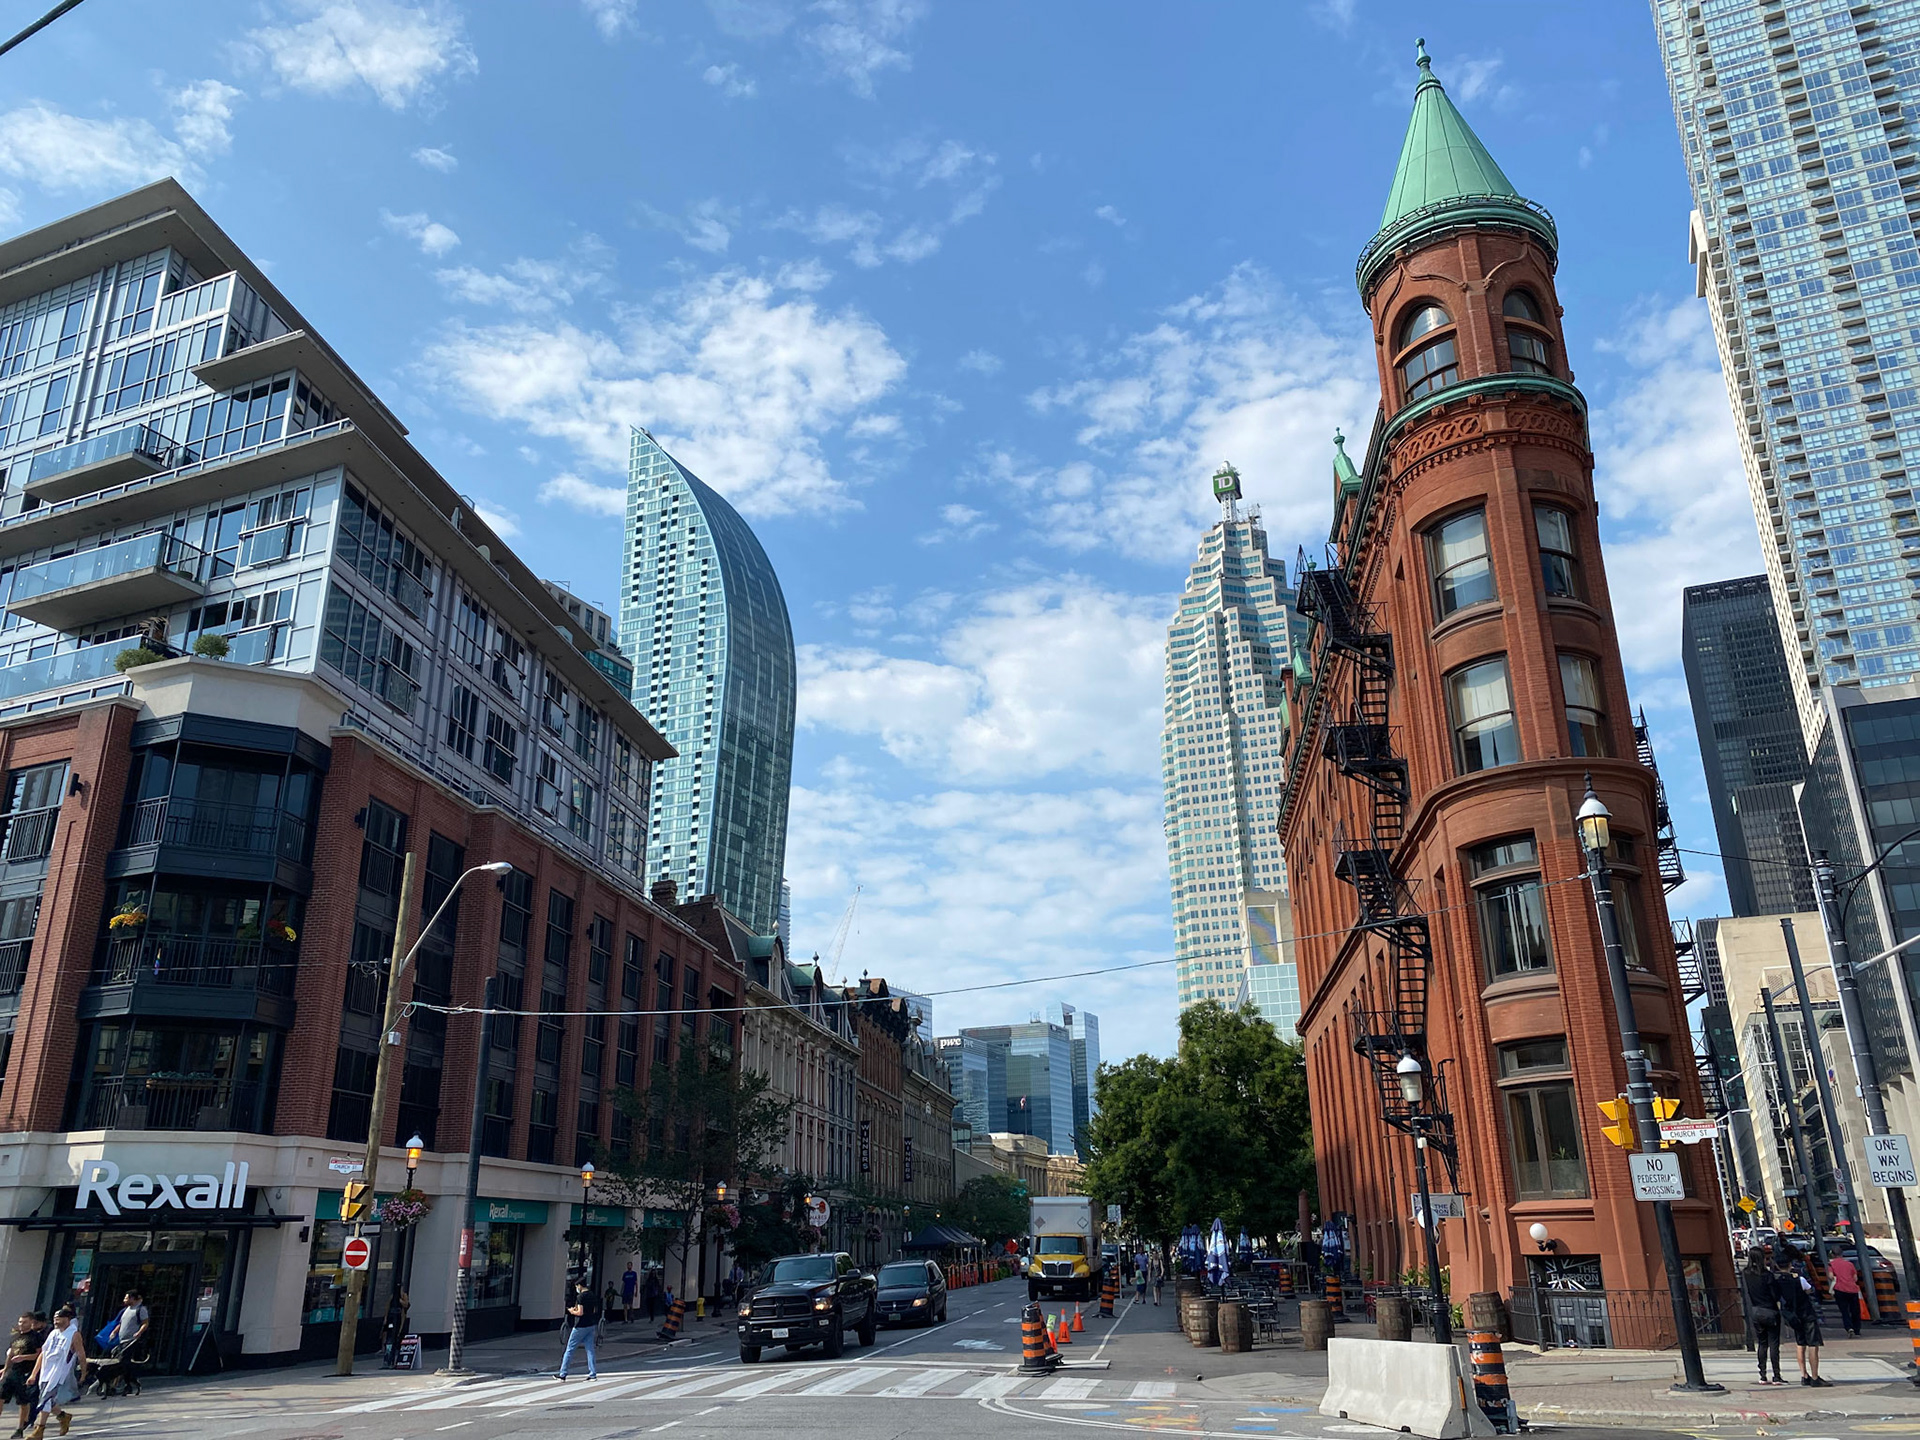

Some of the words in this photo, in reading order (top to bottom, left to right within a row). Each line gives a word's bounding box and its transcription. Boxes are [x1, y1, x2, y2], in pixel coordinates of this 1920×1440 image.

[1215, 476, 1233, 489] TD
[940, 1038, 961, 1049] pwc
[861, 1124, 870, 1170] WINNERS
[1875, 1139, 1899, 1151] ONE
[1647, 1159, 1663, 1172] NO
[1878, 1155, 1900, 1166] WAY
[1873, 1170, 1914, 1183] BEGINS
[75, 1160, 250, 1216] Rexall
[489, 1203, 509, 1220] Rexall
[1579, 1265, 1598, 1273] THE
